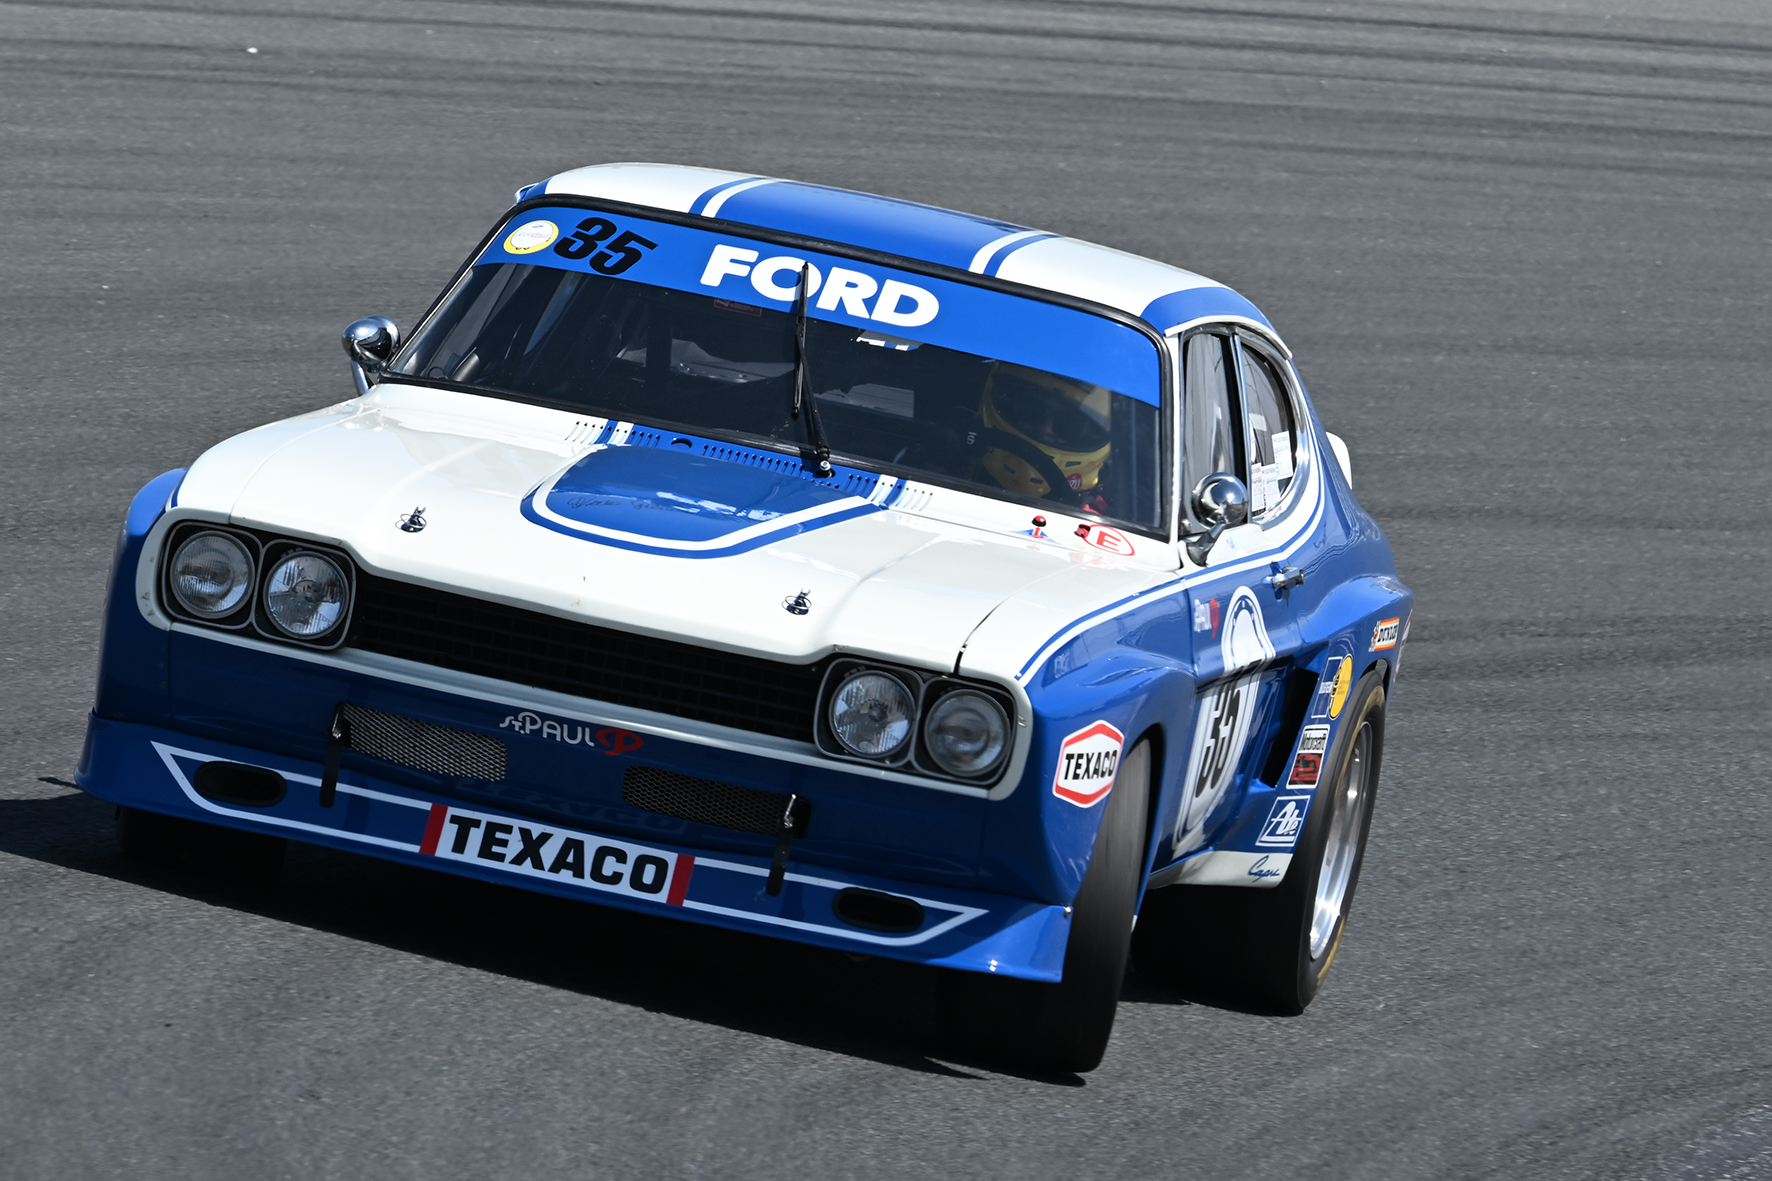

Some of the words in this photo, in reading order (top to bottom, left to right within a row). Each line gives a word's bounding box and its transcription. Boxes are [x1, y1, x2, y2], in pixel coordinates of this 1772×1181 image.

[553, 217, 659, 276] 35
[700, 244, 940, 328] FORD
[1096, 530, 1121, 552] E
[1195, 658, 1263, 799] 35
[1063, 749, 1119, 781] TEXACO
[449, 814, 670, 895] TEXACO
